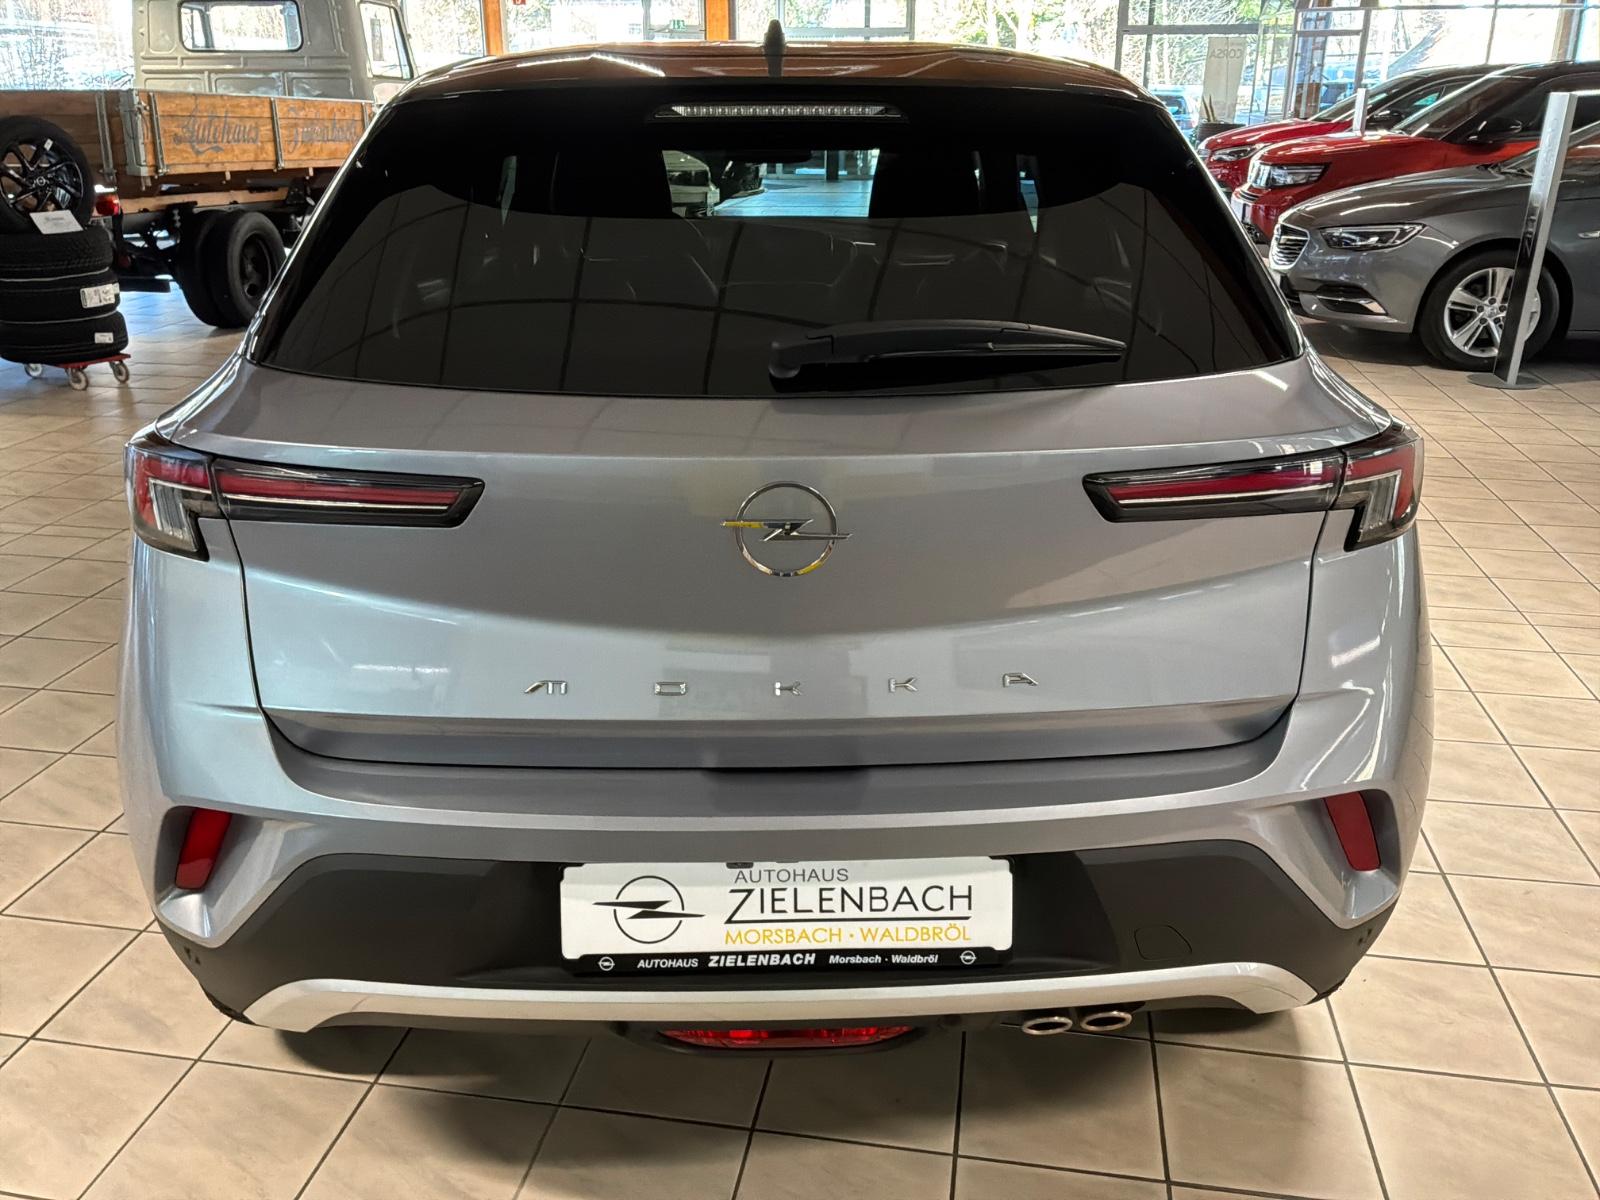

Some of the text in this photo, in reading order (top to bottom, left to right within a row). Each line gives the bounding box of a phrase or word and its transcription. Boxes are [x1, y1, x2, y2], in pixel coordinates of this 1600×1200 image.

[523, 672, 1039, 697] MOKKA
[734, 868, 849, 884] AUTOHAUS
[724, 885, 973, 924] ZIELENBACH
[724, 923, 972, 944] MORSBACH WALDBRÖL
[637, 953, 939, 969] AUTOHAUS ZIELENBACH Morsbach Waldbröl
